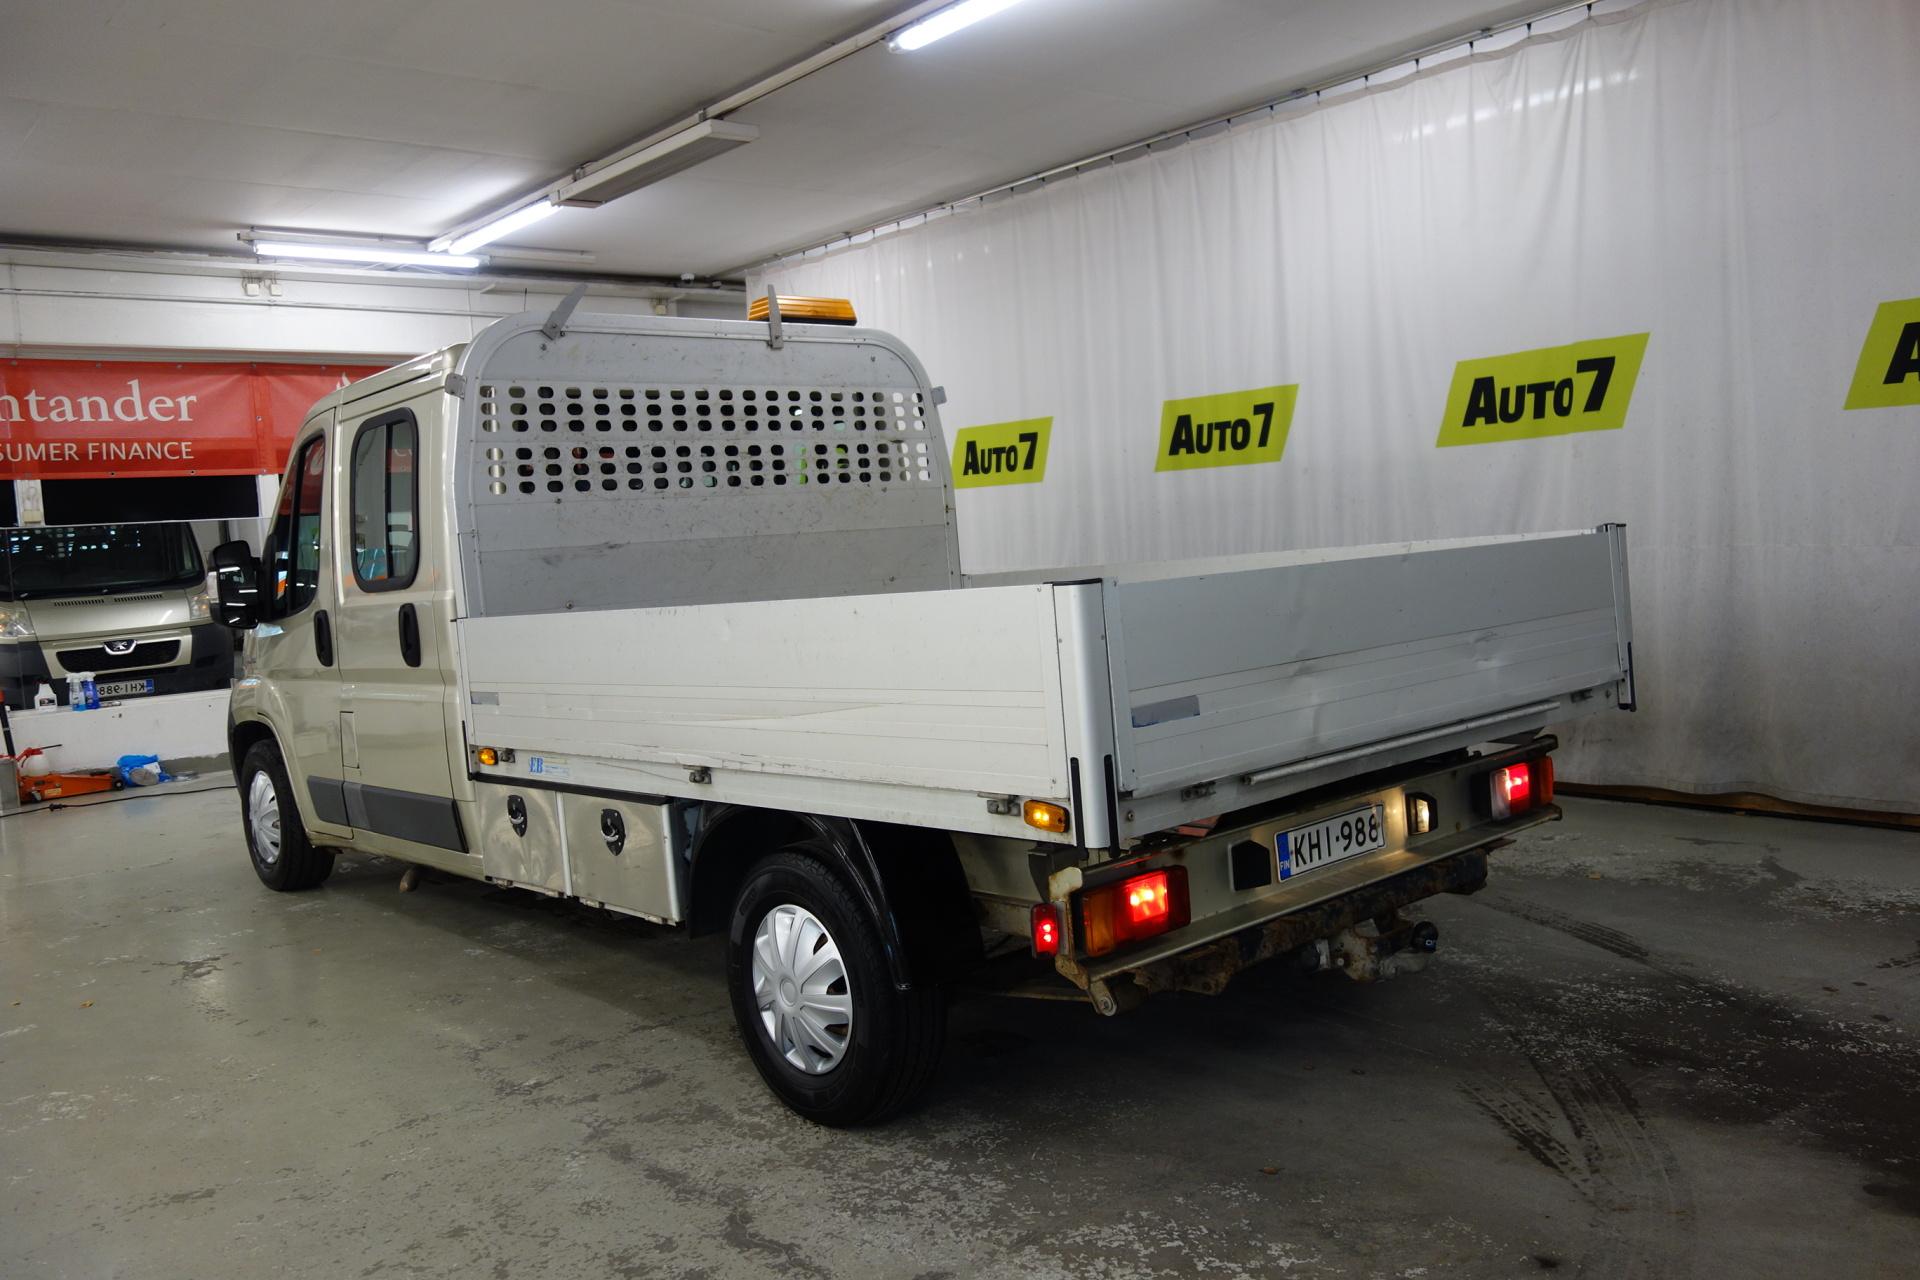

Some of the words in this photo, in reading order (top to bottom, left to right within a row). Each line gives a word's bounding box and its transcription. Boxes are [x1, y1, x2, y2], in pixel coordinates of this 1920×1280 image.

[0, 379, 197, 422] ntander
[88, 441, 195, 462] FINANCE
[1294, 813, 1378, 868] KHI-988
[1280, 859, 1290, 872] FIN
